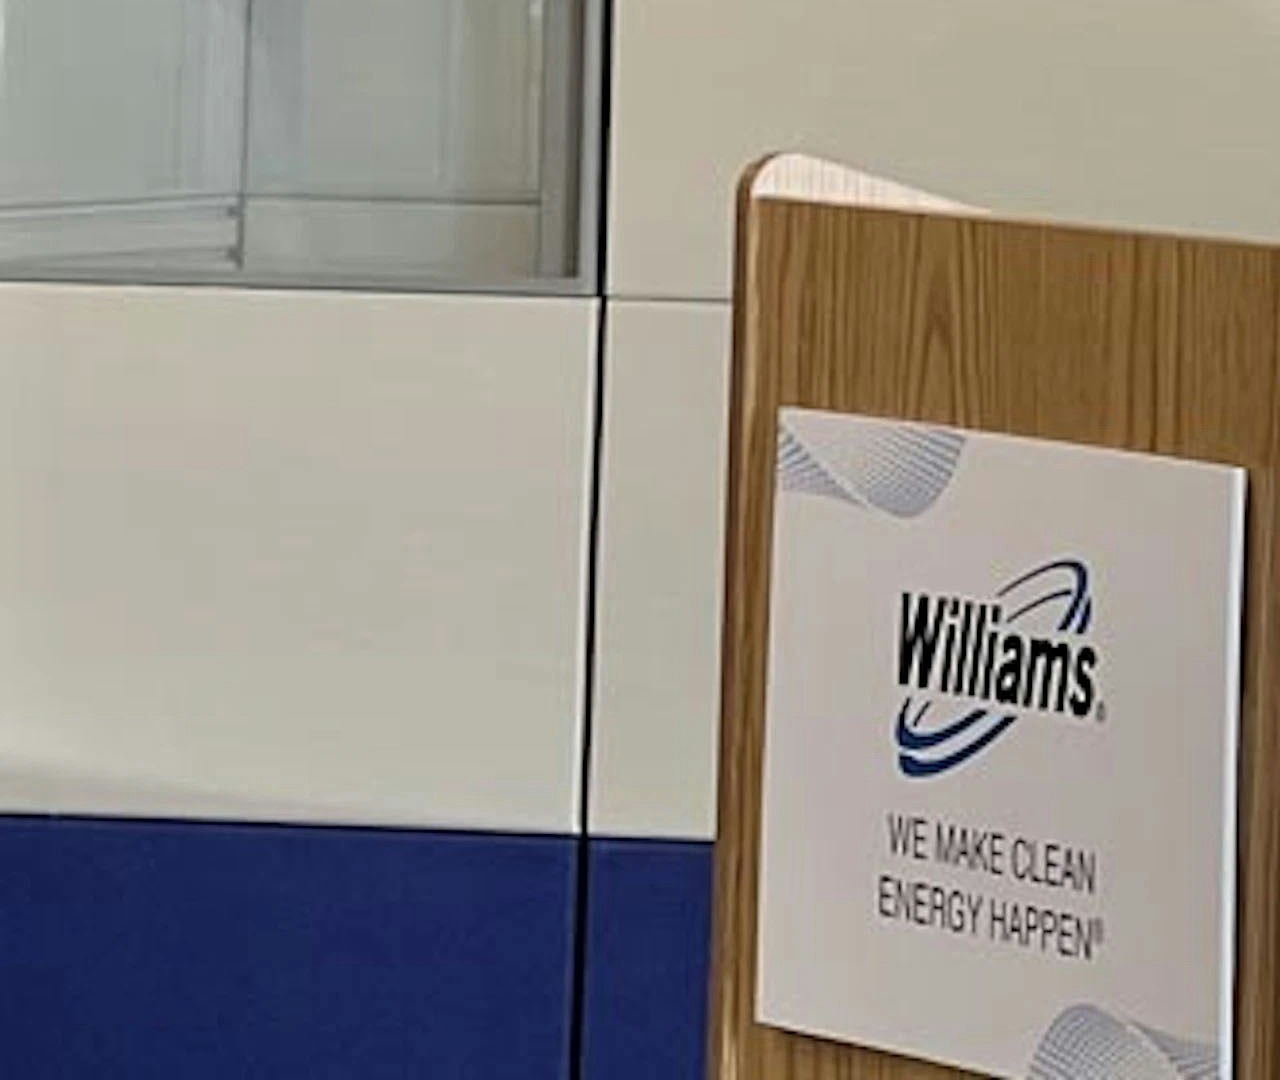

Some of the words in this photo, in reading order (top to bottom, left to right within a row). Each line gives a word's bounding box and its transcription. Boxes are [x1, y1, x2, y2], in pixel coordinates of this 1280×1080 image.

[898, 592, 1097, 717] Williams
[887, 812, 928, 861] WE
[935, 821, 1005, 876] MAKE
[1011, 836, 1096, 896] CLEAN
[878, 873, 983, 936] ENERGY
